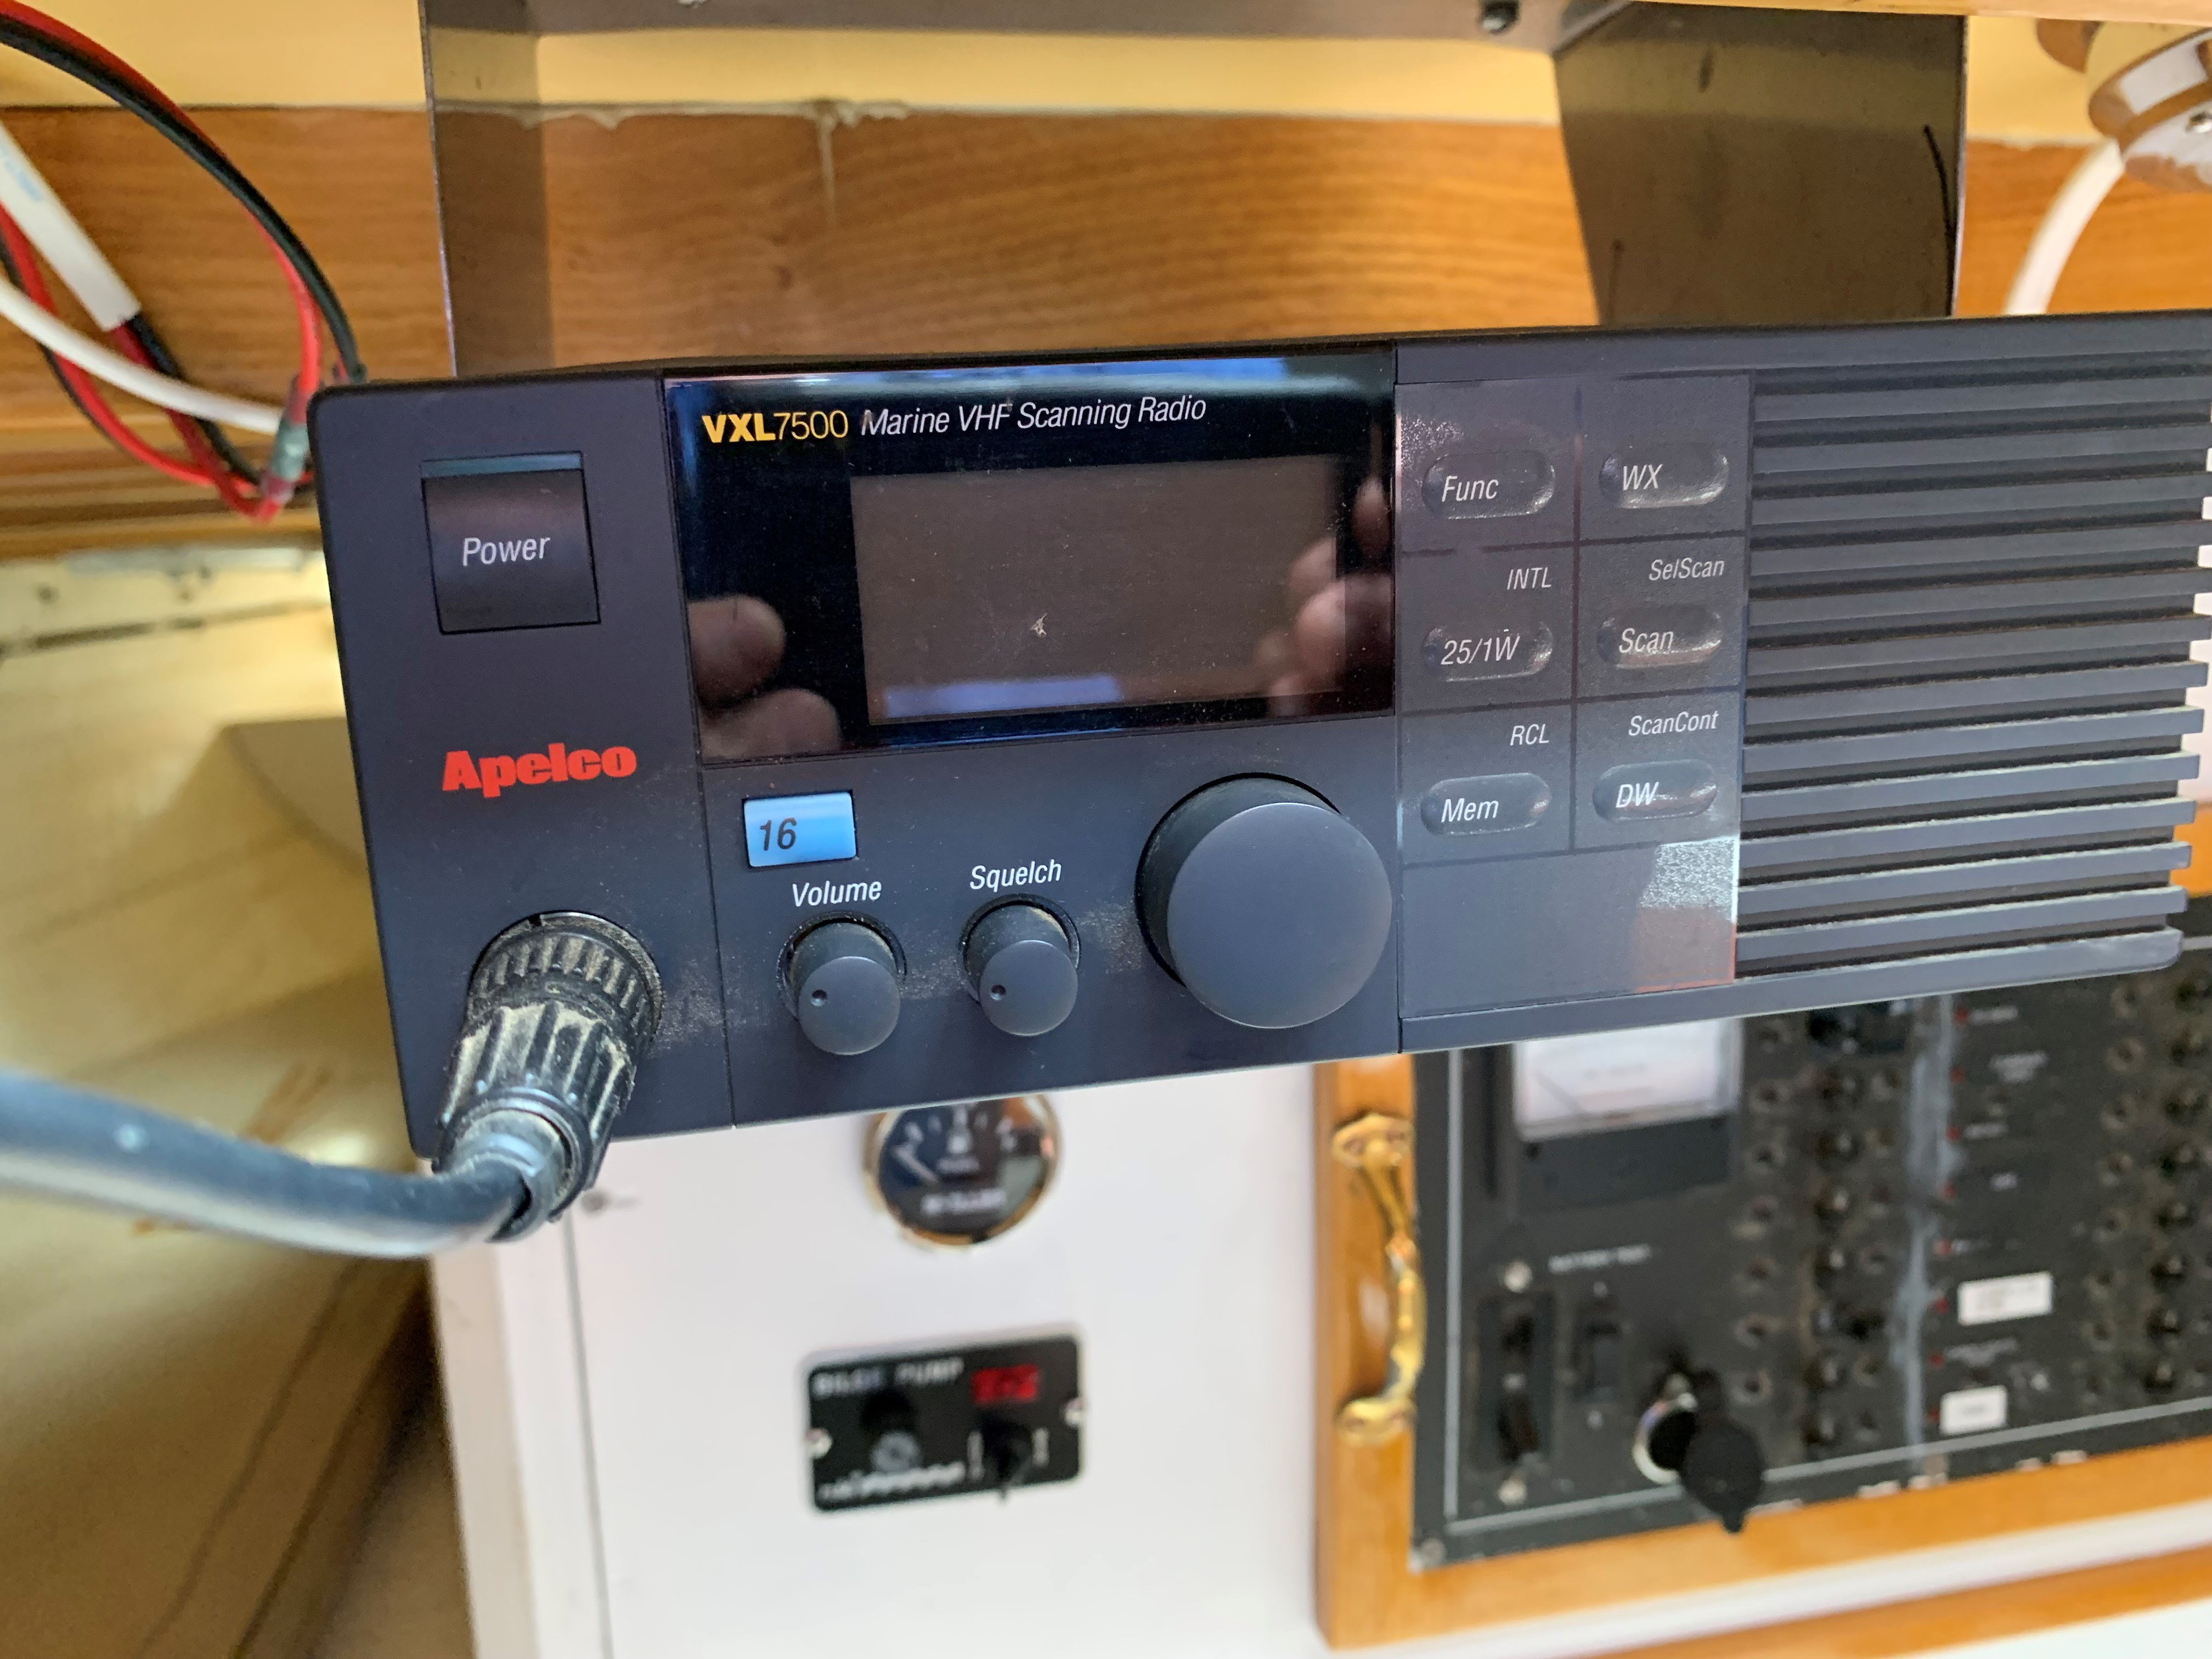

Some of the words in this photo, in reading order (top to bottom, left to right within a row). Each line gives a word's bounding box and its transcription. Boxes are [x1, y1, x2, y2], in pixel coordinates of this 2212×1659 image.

[702, 410, 849, 443] VXL7500
[861, 408, 950, 436] Marine
[958, 404, 1013, 432] VHF
[1017, 399, 1132, 430] Scanning
[1138, 394, 1206, 422] Radio
[1442, 475, 1499, 502] Func
[1622, 464, 1663, 490] WX
[462, 536, 550, 566] Power
[1507, 567, 1552, 590] INTL
[1649, 557, 1725, 581] SelScan
[1441, 635, 1520, 665] 25/1W
[1618, 628, 1674, 654] Scan
[1510, 724, 1549, 746] RCL
[1628, 710, 1719, 736] ScanCont
[442, 742, 637, 799] Apelco
[1616, 781, 1659, 808] DW
[1441, 797, 1499, 822] Mem
[760, 817, 797, 851] 16
[970, 859, 1062, 892] Squelch
[792, 880, 882, 907] Volume
